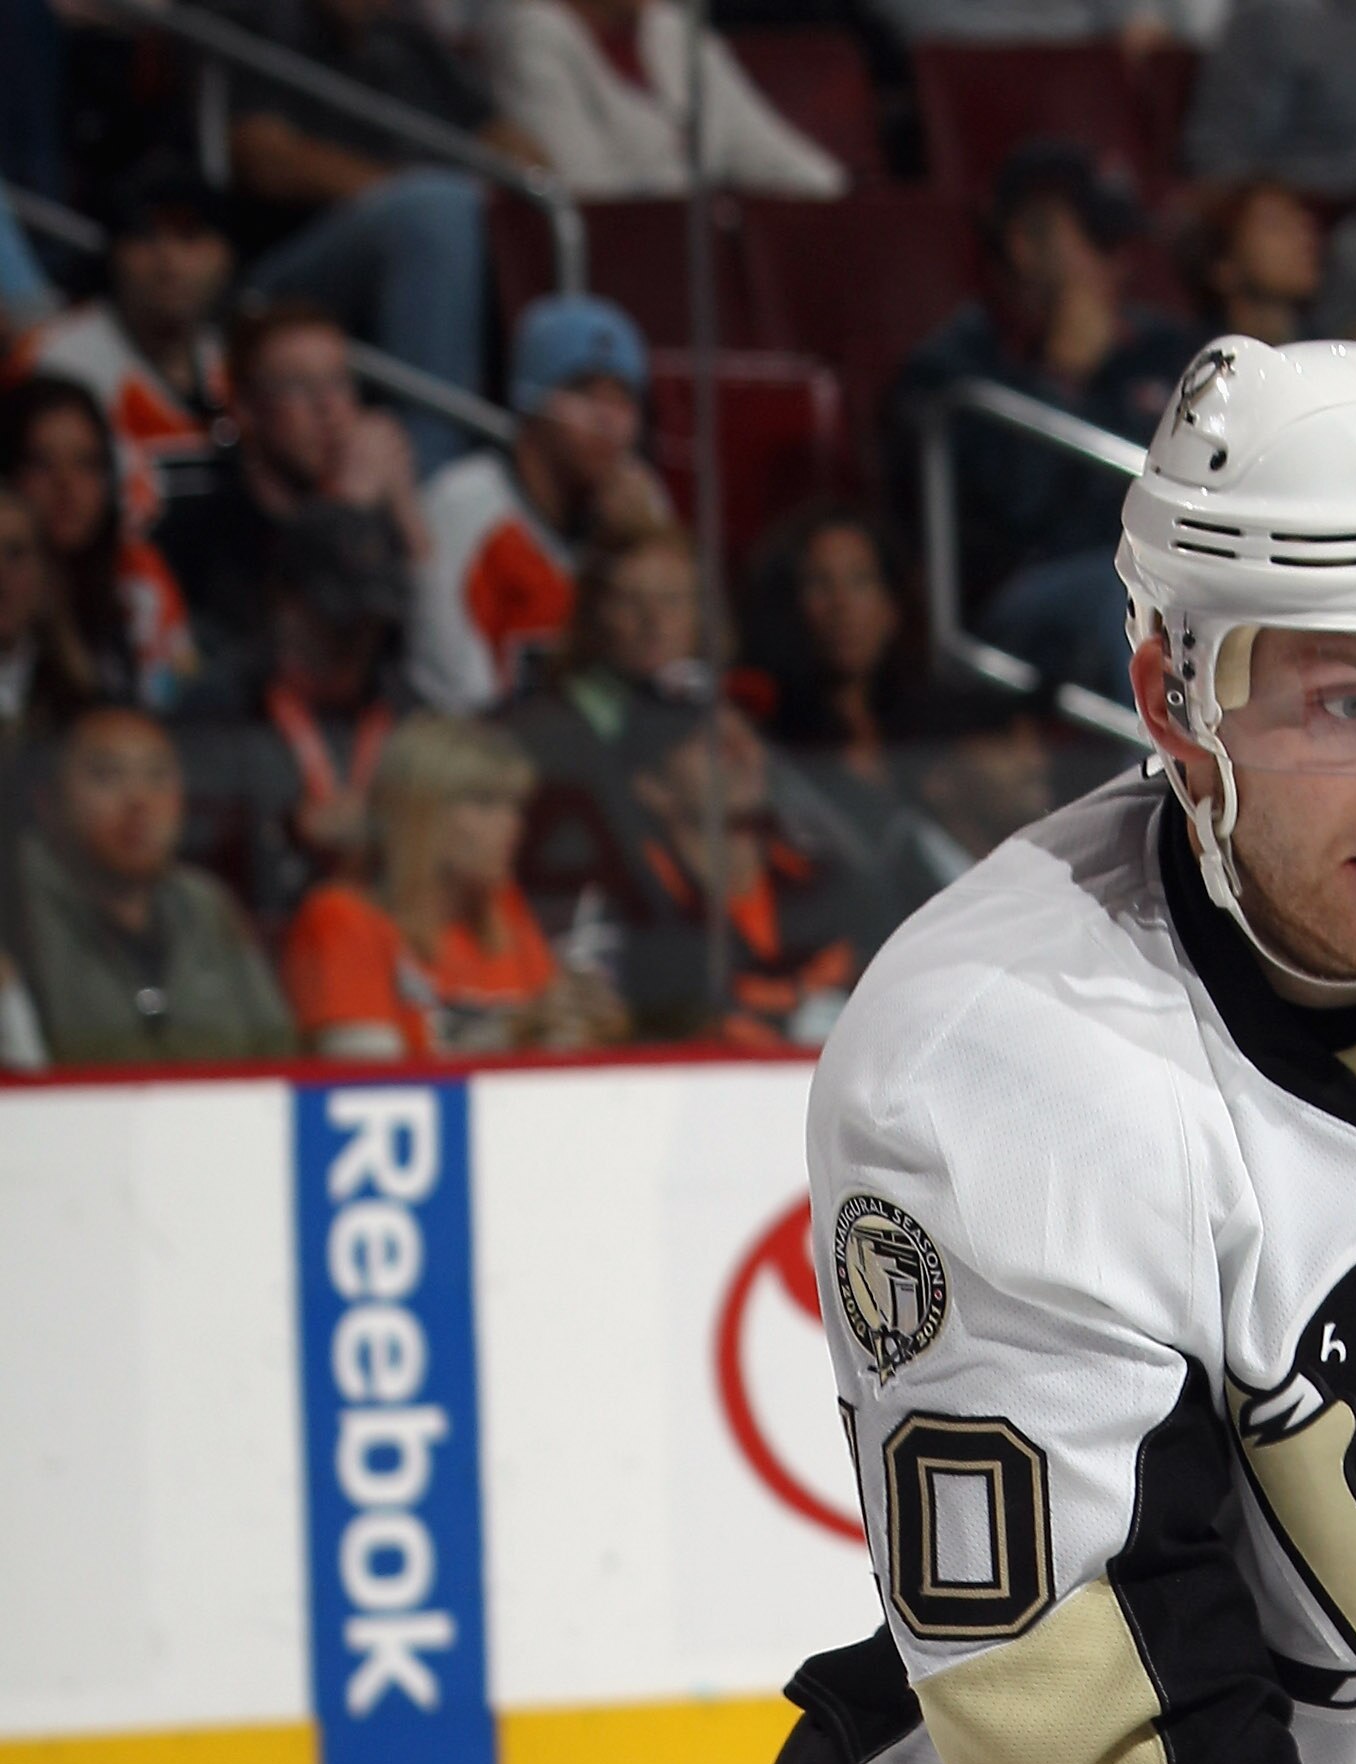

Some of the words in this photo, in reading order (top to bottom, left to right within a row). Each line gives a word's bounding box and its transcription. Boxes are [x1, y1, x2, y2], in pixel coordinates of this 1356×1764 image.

[836, 1197, 888, 1261] INAUGURAL
[892, 1210, 943, 1285] SEASON
[842, 1284, 867, 1338] 2010
[916, 1309, 943, 1347] 2011
[326, 1086, 455, 1719] Reebok
[838, 1397, 1056, 1641] 0
